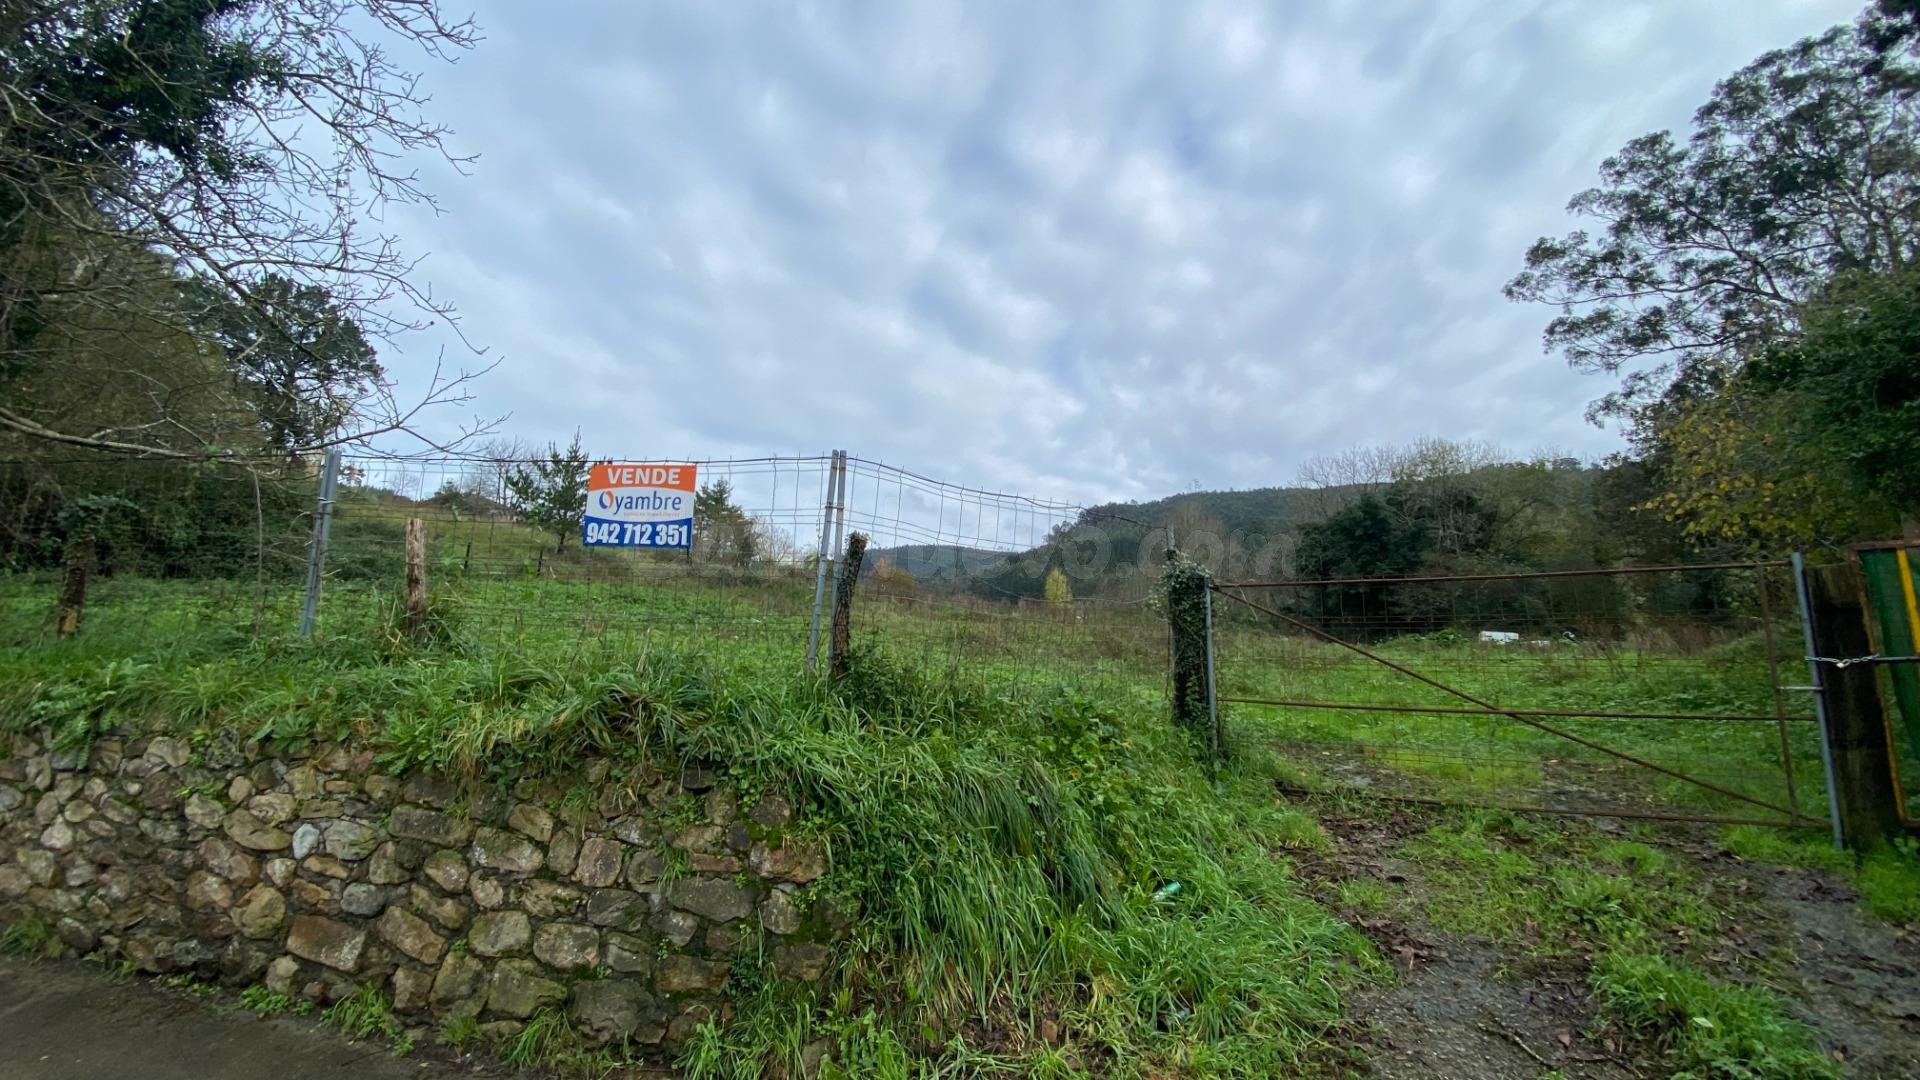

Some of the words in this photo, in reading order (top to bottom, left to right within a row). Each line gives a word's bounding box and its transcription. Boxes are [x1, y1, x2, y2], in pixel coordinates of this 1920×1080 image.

[607, 468, 681, 485] VENDE
[599, 490, 682, 515] Oyambre
[586, 523, 620, 544] 942
[623, 523, 653, 545] 712
[655, 523, 689, 545] 351
